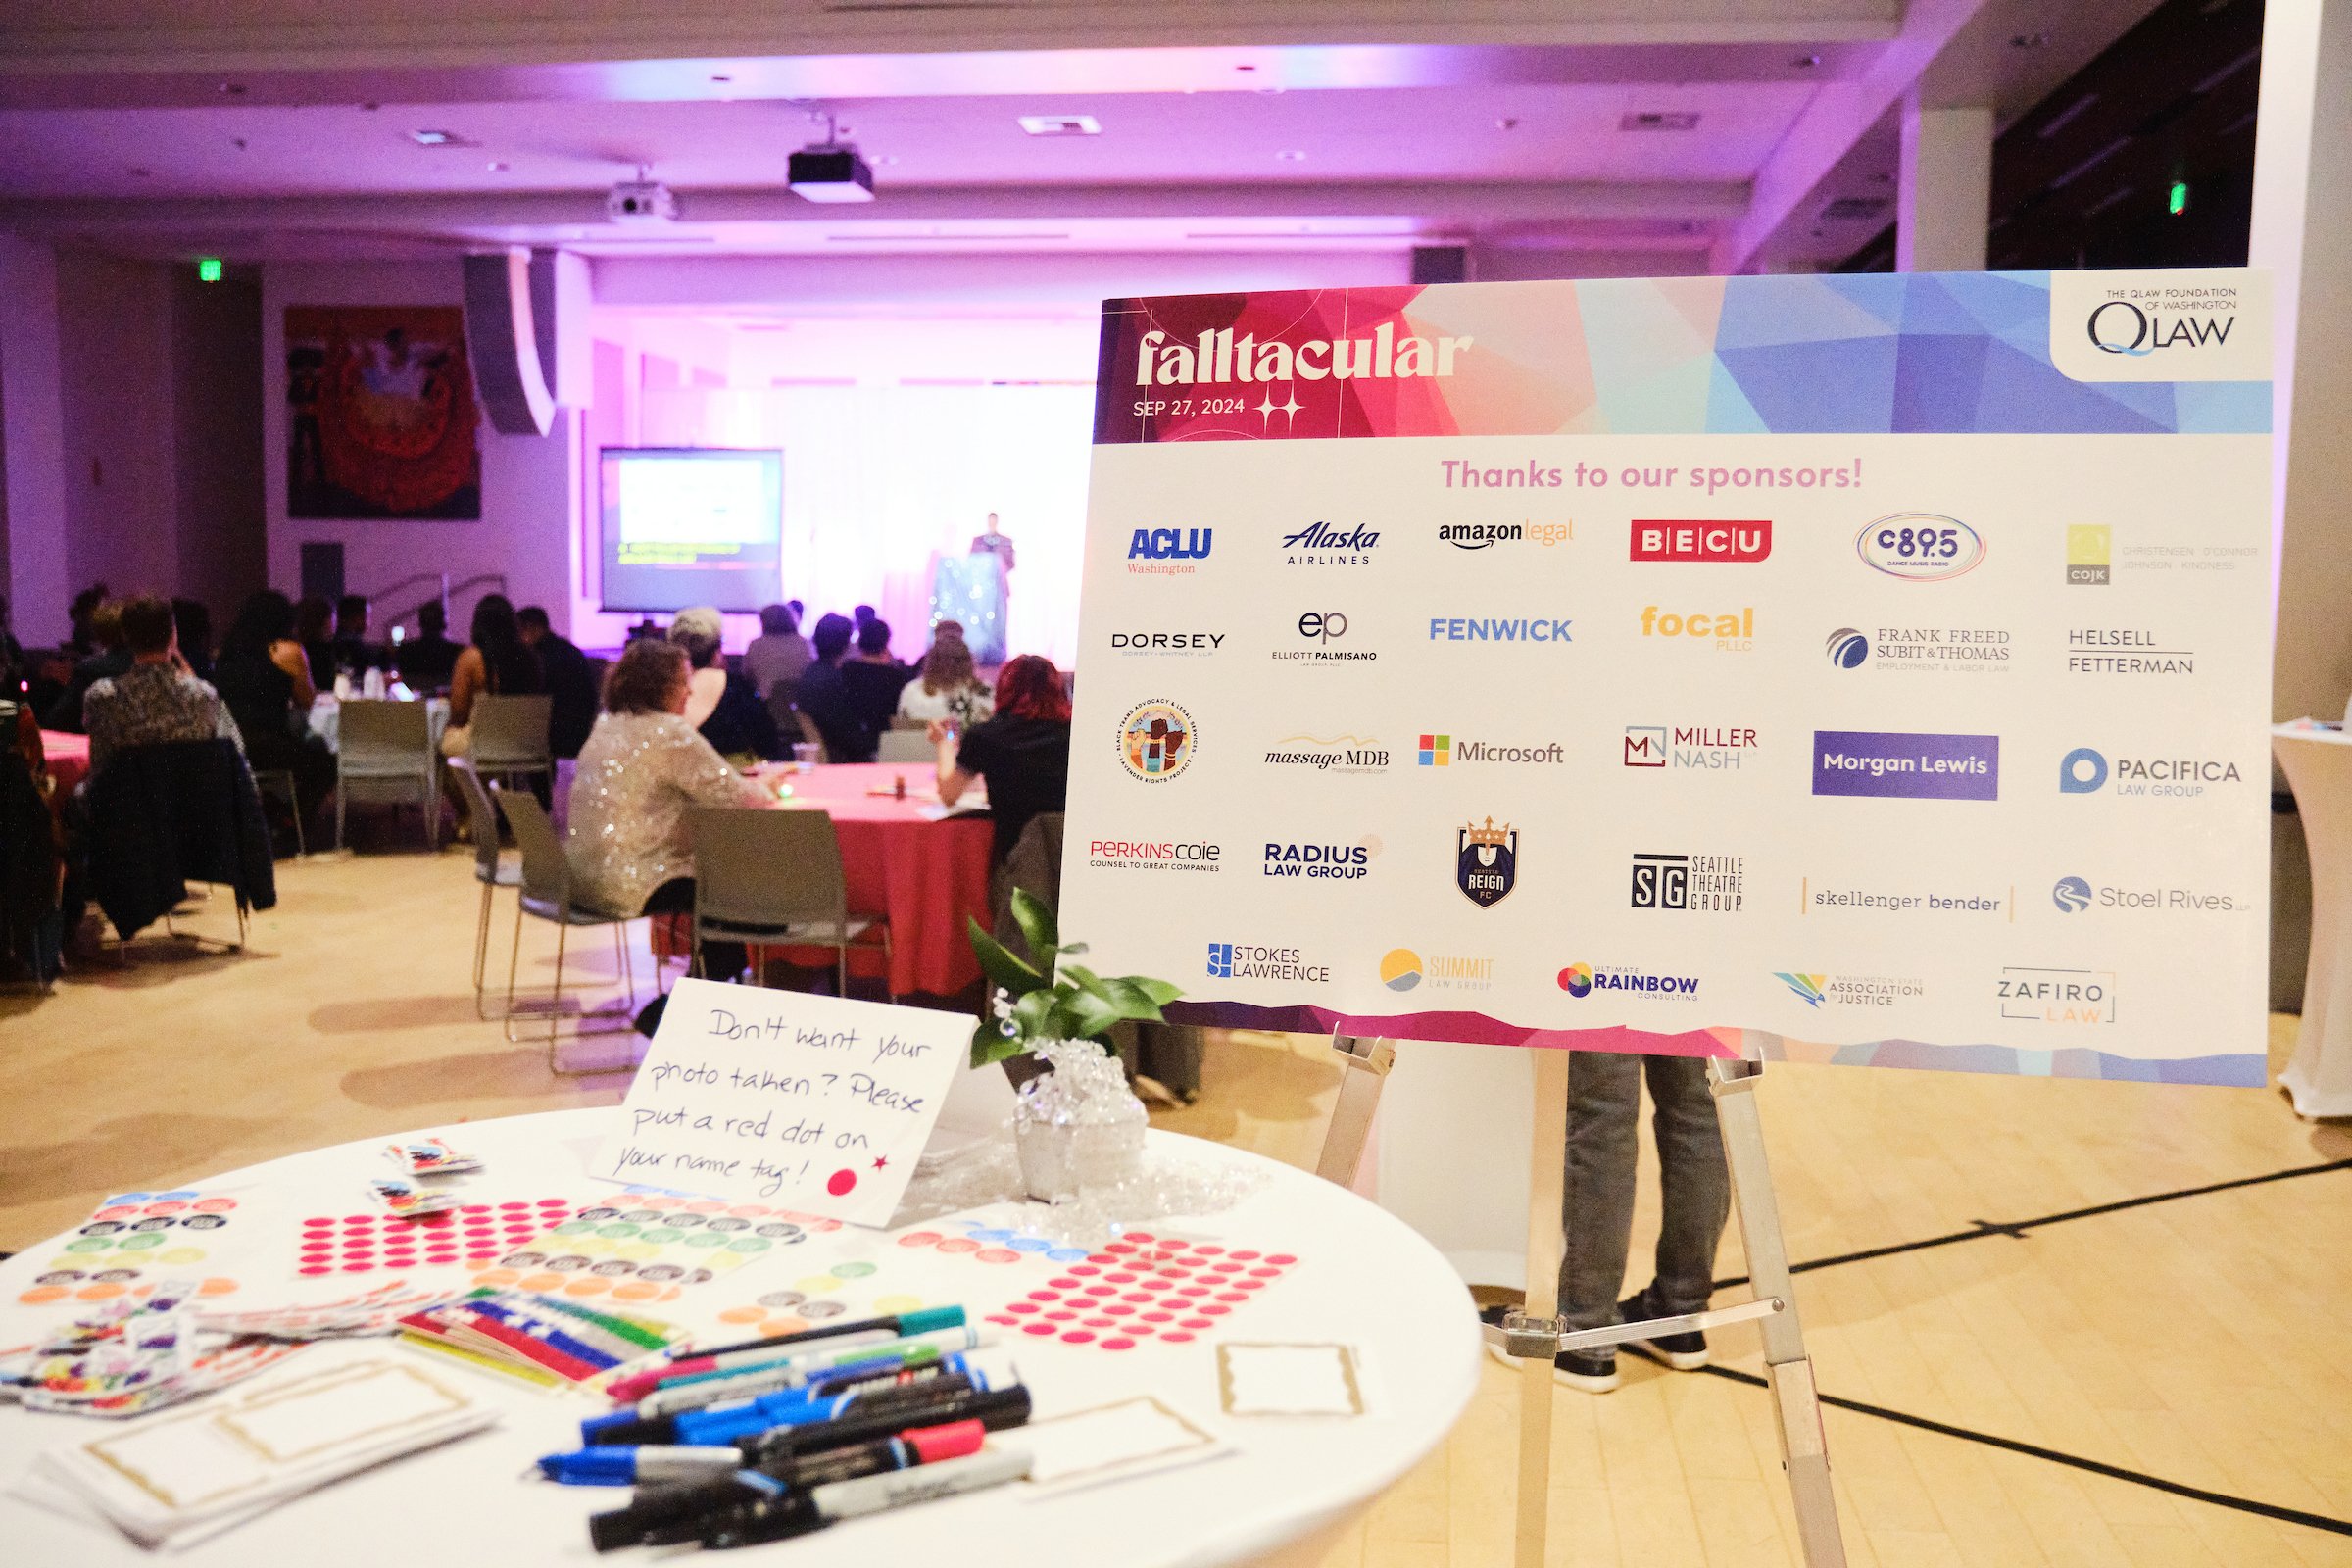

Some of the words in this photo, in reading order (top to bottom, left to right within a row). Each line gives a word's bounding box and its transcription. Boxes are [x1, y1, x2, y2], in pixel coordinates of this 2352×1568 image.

[2130, 289, 2161, 298] QLAW
[2166, 288, 2237, 298] FOUNDATION
[2145, 301, 2159, 311] OF
[2163, 300, 2237, 310] WASHINGTON
[1135, 321, 1473, 386] falltacular
[1133, 401, 1166, 416] SEP
[1170, 400, 1196, 417] 27,
[1201, 398, 1246, 415] 2024
[1441, 459, 1563, 488] Thanks
[1575, 462, 1608, 488] to
[1620, 466, 1678, 488] our
[1690, 458, 1862, 496] sponsors!
[1127, 528, 1212, 560] ACLU
[1282, 521, 1381, 552] Alaska
[1287, 556, 1370, 565] AIRLINES
[2122, 546, 2194, 557] CHRISTENSEN
[1127, 563, 1196, 576] Washington
[2123, 561, 2172, 570] JOHNSON
[2180, 561, 2235, 570] KINDNESS
[2071, 569, 2105, 583] COJK
[1298, 612, 1348, 645] ep
[1430, 618, 1573, 642] FENWICK
[1641, 606, 1754, 639] focal
[1111, 633, 1225, 649] DORSEY
[1878, 628, 1941, 643] FRANK
[1949, 630, 2010, 644] FREED
[2069, 629, 2156, 646] HELSELL
[1716, 640, 1752, 652] PLLC
[1936, 647, 2010, 661] THOMAS
[1272, 651, 1313, 660] ELLIOTT
[1315, 652, 1377, 661] PALMISANO
[1876, 662, 1940, 671] EMPLOYMENT
[1943, 663, 1950, 672] &
[1953, 663, 1984, 672] LABOR
[1987, 664, 2010, 673] LAW
[2069, 658, 2194, 674] FETTERMAN
[1675, 727, 1758, 748] MILLER
[1264, 751, 1342, 770] massage
[1346, 750, 1390, 766] MDB
[1457, 741, 1564, 764] Microsoft
[1674, 751, 1740, 769] NASH
[1823, 753, 1915, 776] Morgan
[1921, 756, 1987, 774] Lewis
[2118, 760, 2241, 782] PACIFICA
[2117, 784, 2146, 796] LAW
[2151, 784, 2204, 797] GROUP
[1264, 843, 1368, 865] RADIUS
[1090, 859, 1127, 868] COUNSEL
[1129, 860, 1141, 869] TO
[1143, 861, 1169, 870] GREAT
[1171, 862, 1220, 872] COMPANIES
[1264, 863, 1302, 877] LAW
[1306, 865, 1368, 880] GROUP
[1692, 856, 1743, 874] SEATTLE
[1468, 874, 1504, 892] REIGN
[1692, 874, 1743, 893] THEATRE
[1479, 891, 1492, 900] FC
[1690, 894, 1742, 911] GROUP
[1815, 890, 1922, 910] skellenger
[1929, 894, 2000, 910] bender
[2100, 887, 2162, 907] Stoel
[2169, 890, 2233, 911] Rives
[1234, 946, 1300, 964] STOKES
[1233, 963, 1330, 982] LAWRENCE
[1430, 956, 1494, 979] SUMMIT
[1429, 980, 1450, 989] LAW
[1457, 981, 1492, 990] GROUP
[1594, 973, 1699, 993] RAINBOW
[1829, 982, 1923, 996] ASSOCIATION
[1997, 980, 2103, 1003] ZAFIRO
[1638, 992, 1698, 1002] CONSULTING
[1838, 994, 1893, 1005] JUSTICE
[2046, 1007, 2102, 1025] LAW
[796, 1027, 861, 1051] want
[872, 1034, 931, 1064] your
[651, 1060, 719, 1092] photo
[850, 1073, 925, 1114] Please
[634, 1107, 689, 1135] put
[693, 1113, 714, 1131] a
[725, 1110, 772, 1139] red
[782, 1118, 824, 1144] dot
[835, 1130, 869, 1150] on
[612, 1146, 666, 1177] your
[674, 1153, 741, 1177] name
